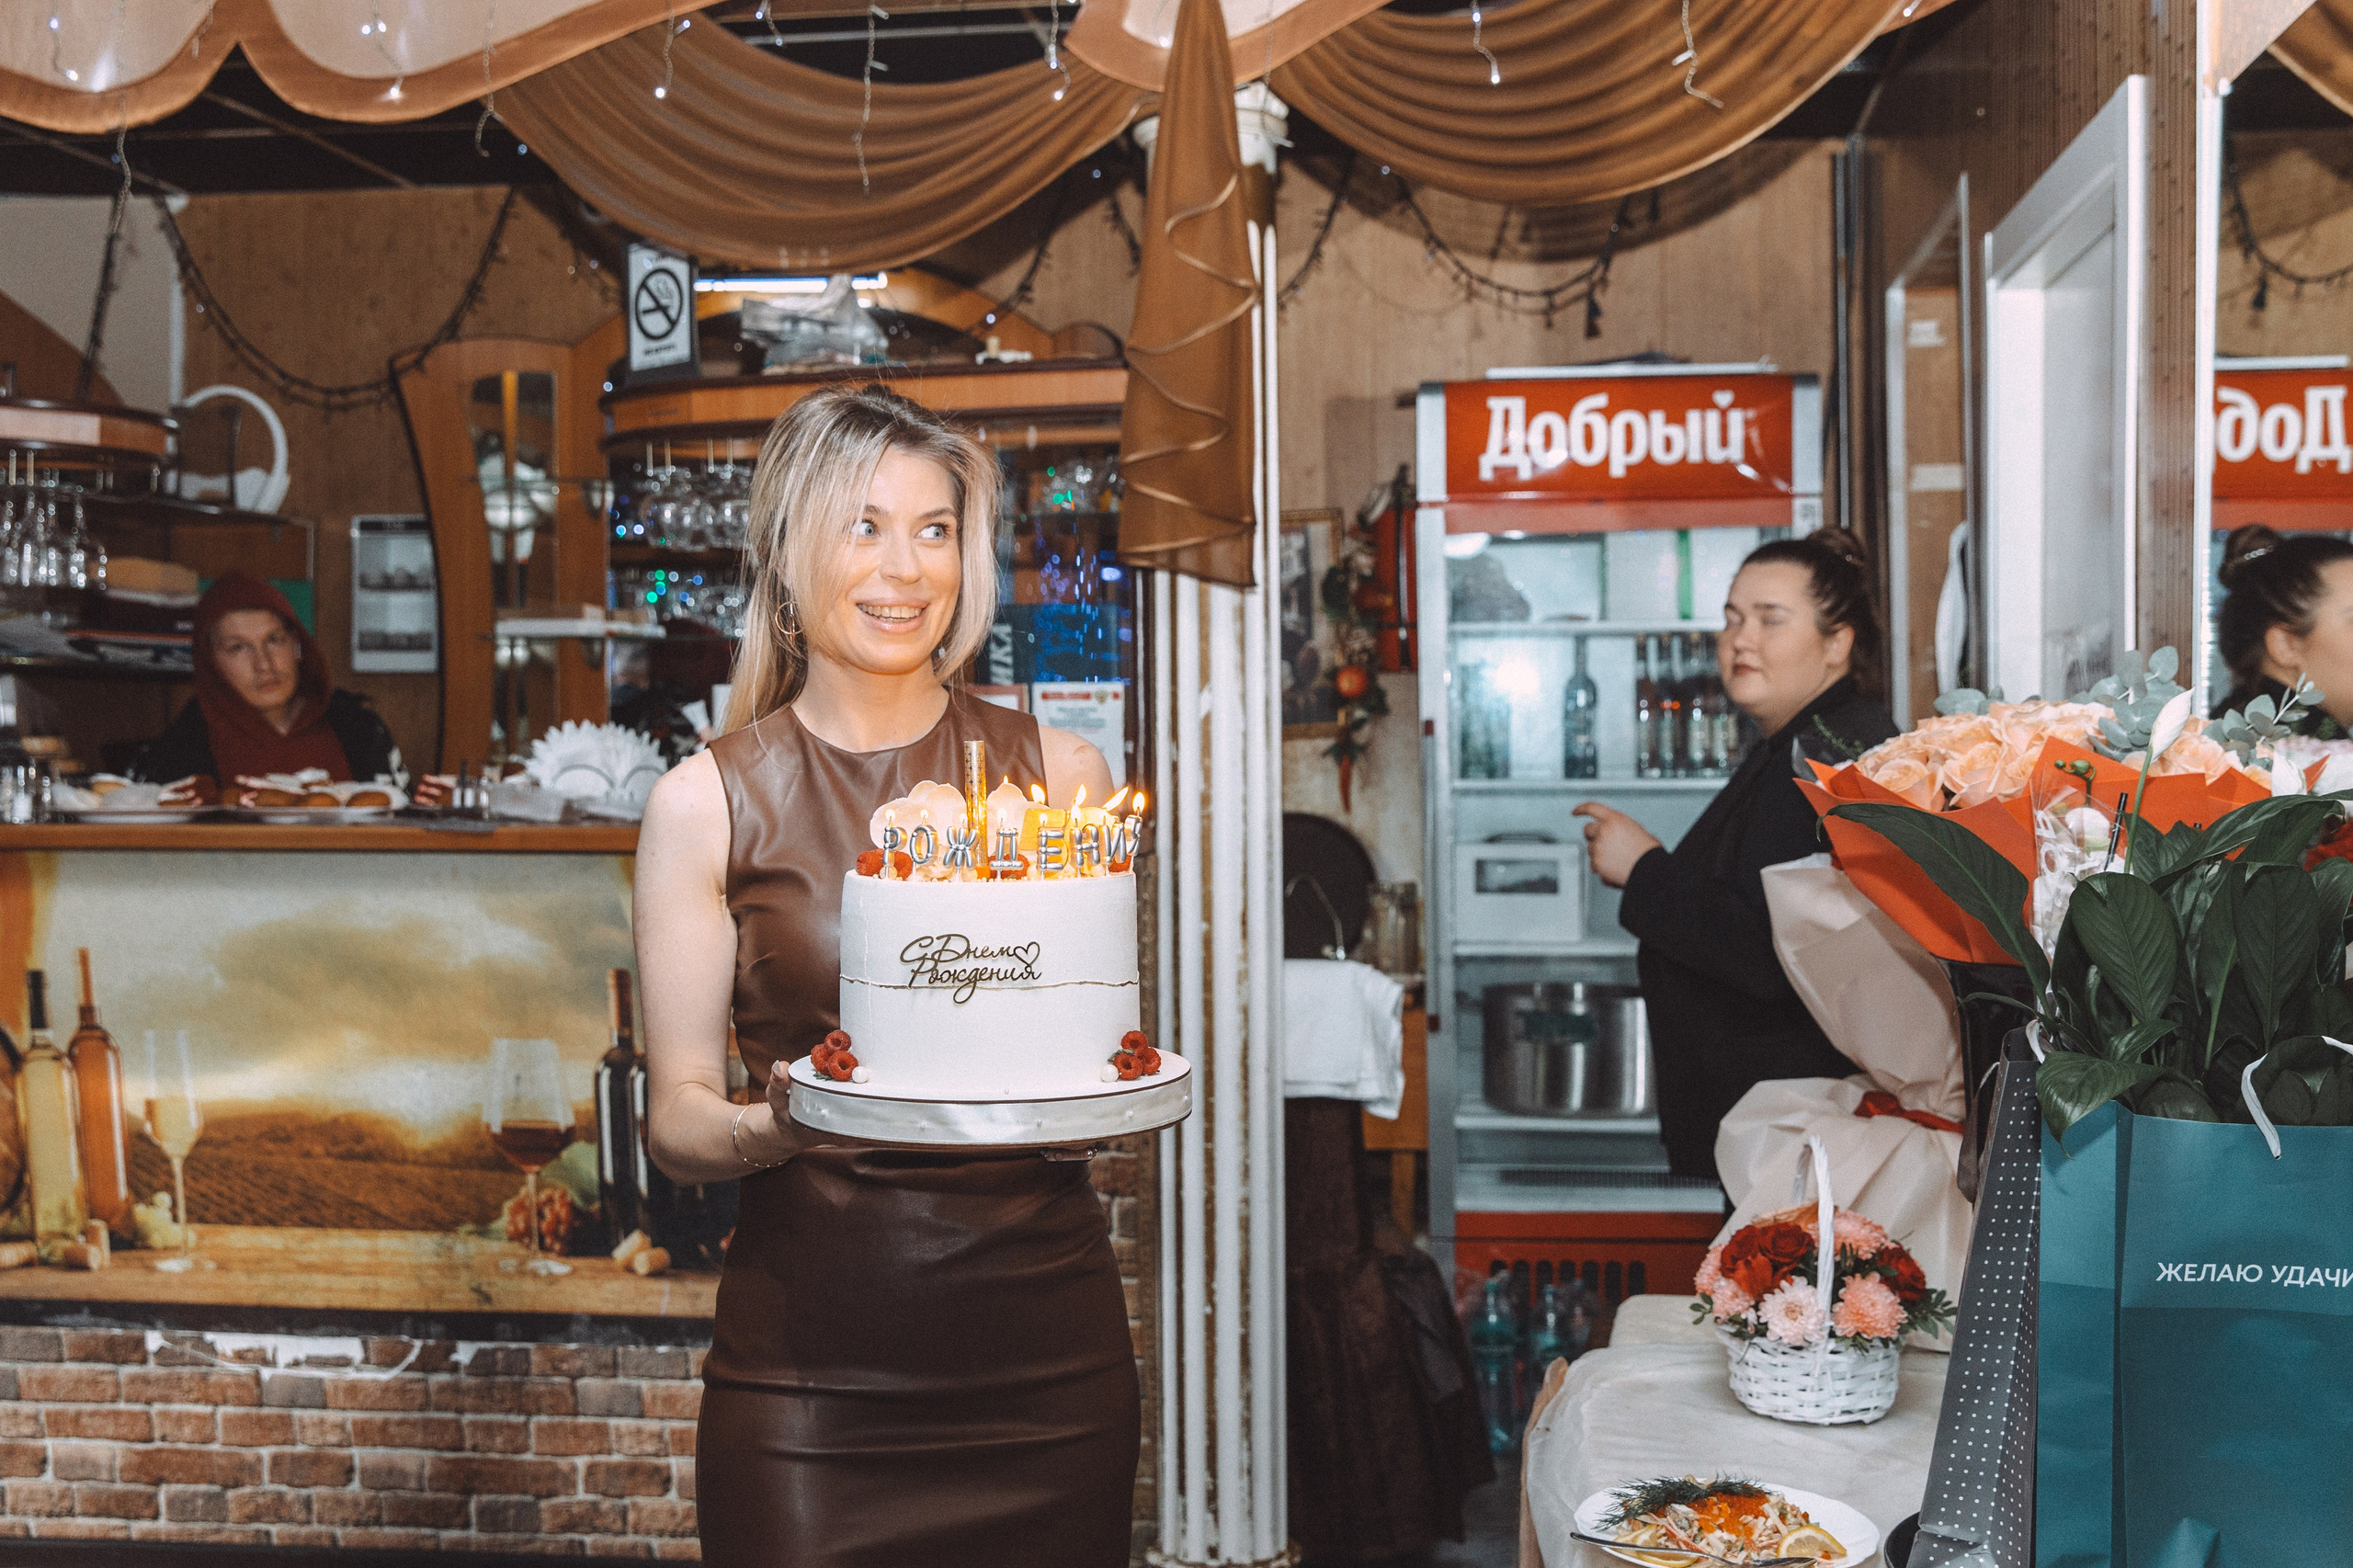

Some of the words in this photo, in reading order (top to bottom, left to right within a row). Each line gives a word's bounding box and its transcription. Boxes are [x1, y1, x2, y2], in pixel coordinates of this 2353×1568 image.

[1478, 390, 1745, 481] Добрый
[908, 958, 1042, 1005] Рождения
[2155, 1262, 2264, 1283] ЖЕЛАЮ
